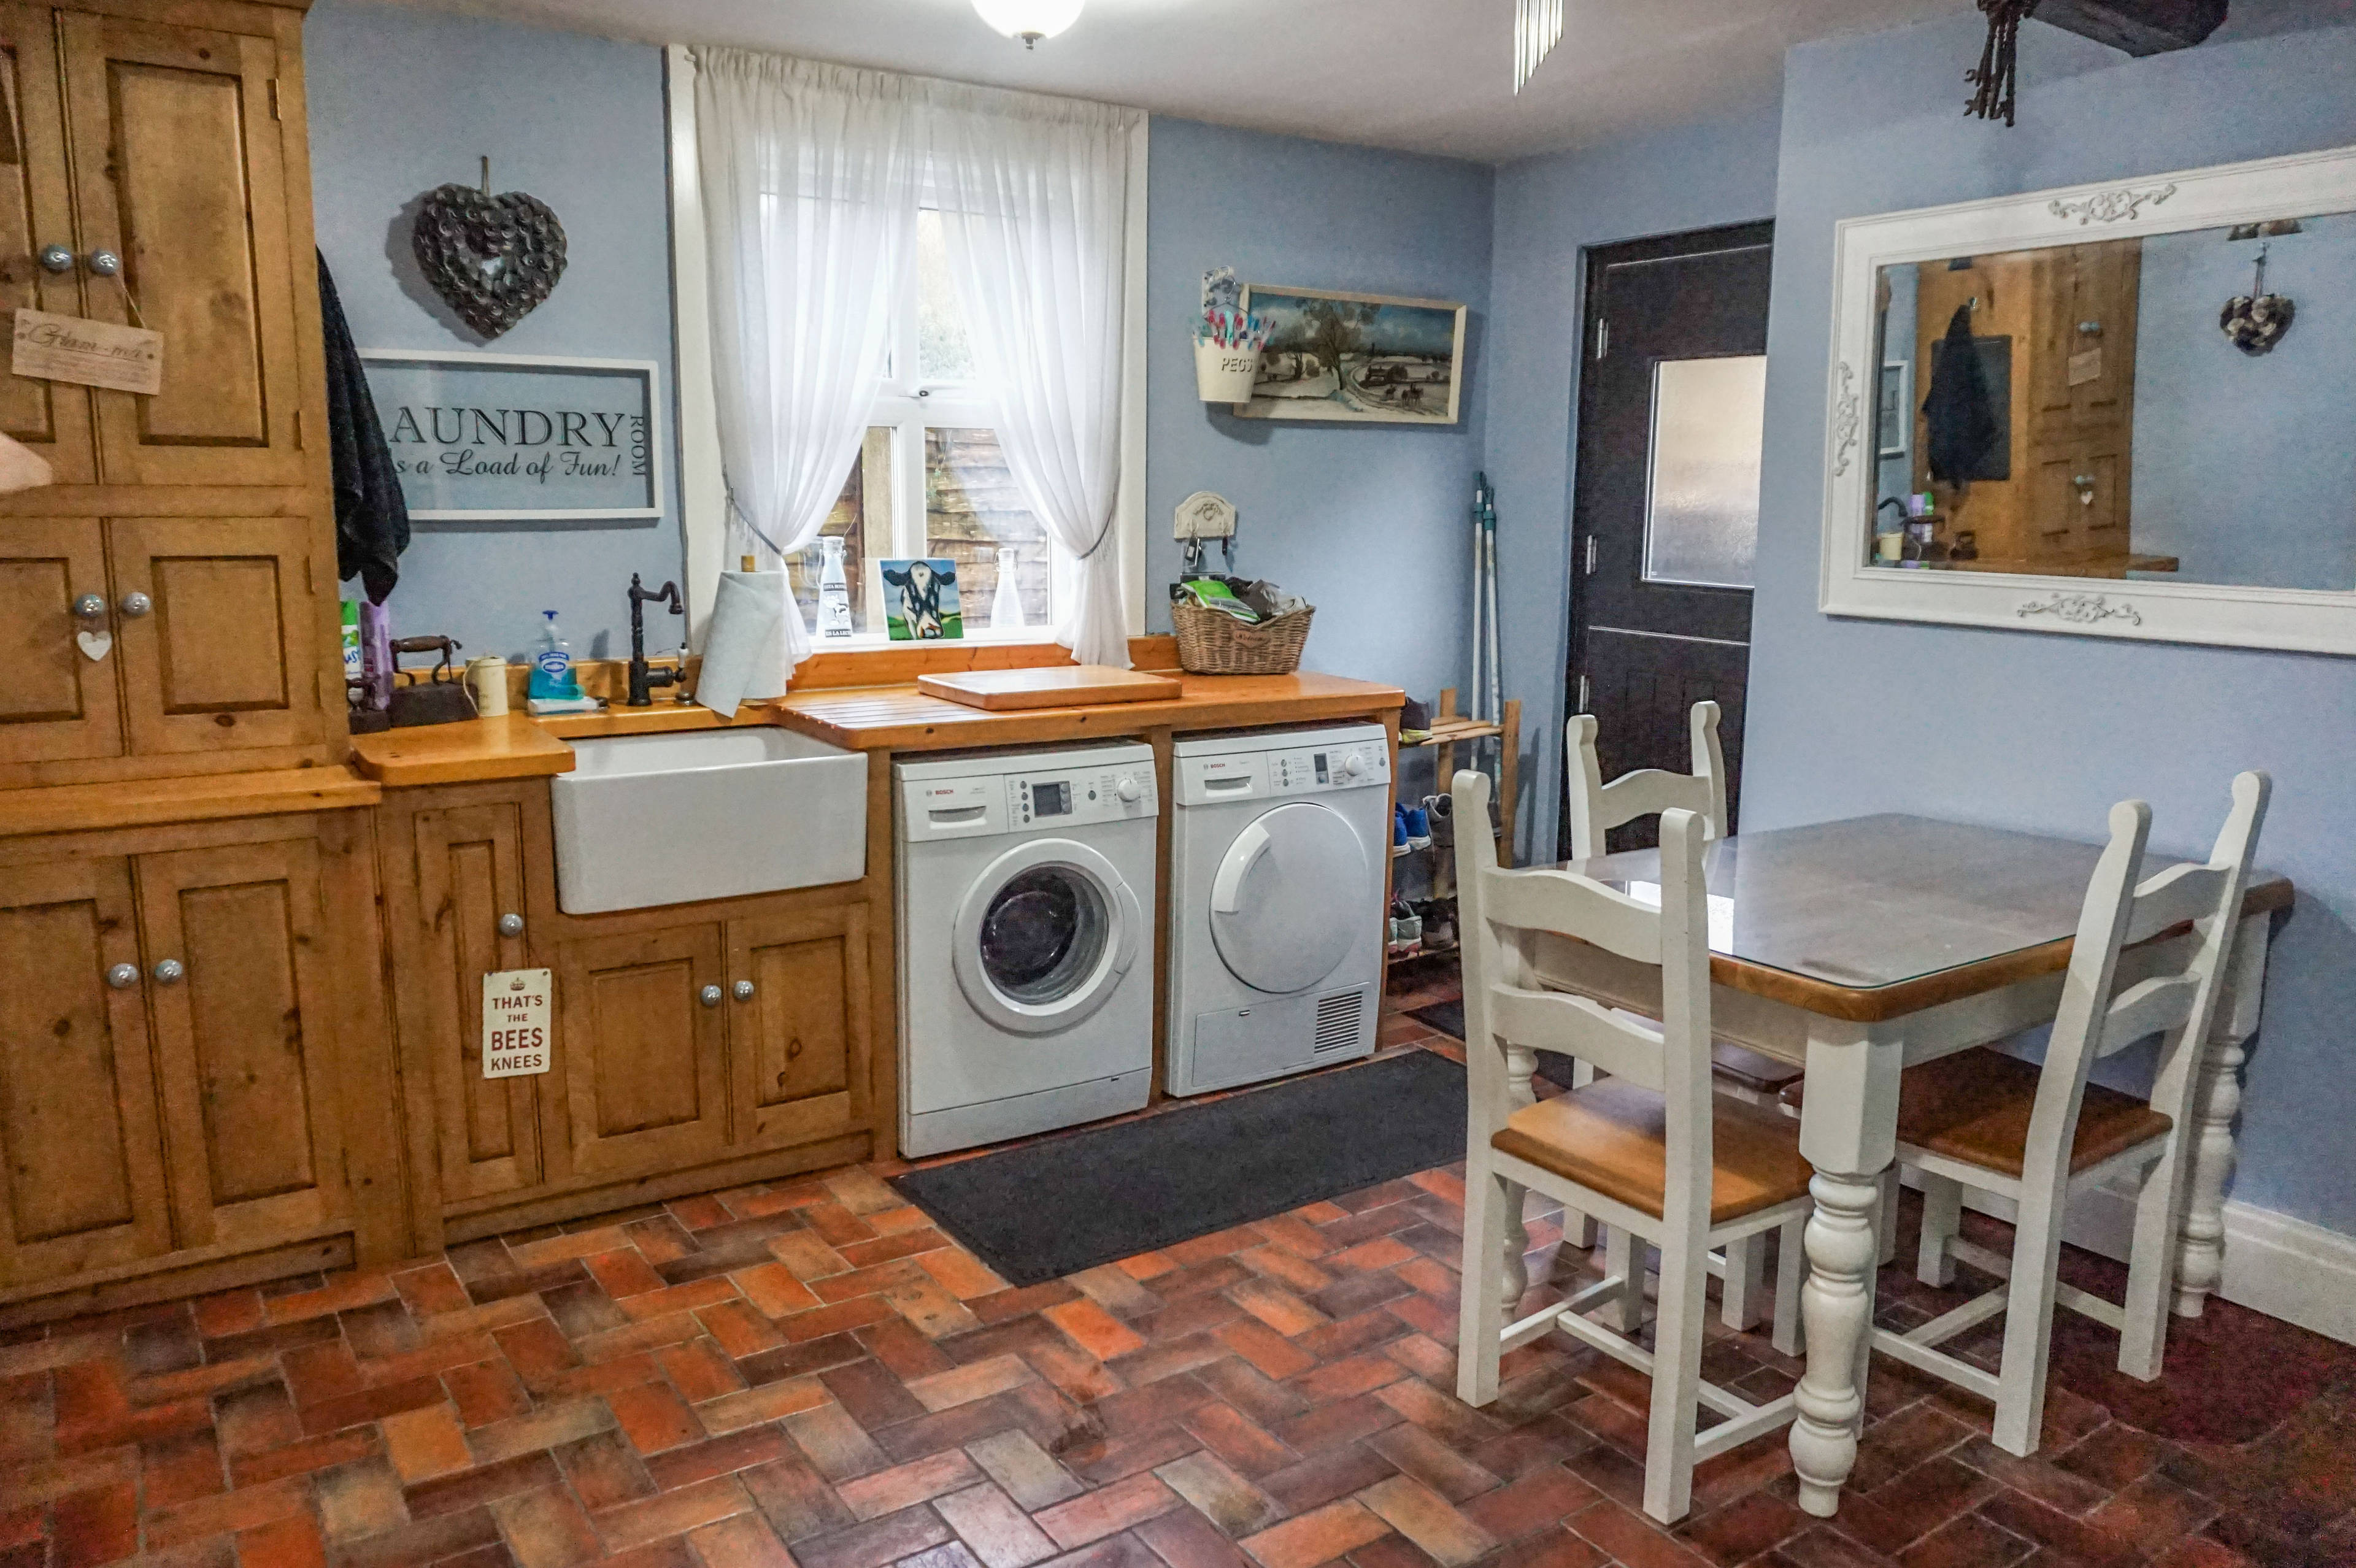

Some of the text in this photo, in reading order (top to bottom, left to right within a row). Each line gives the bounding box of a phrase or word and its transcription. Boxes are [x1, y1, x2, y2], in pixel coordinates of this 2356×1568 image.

[1222, 358, 1253, 372] PEGS
[390, 406, 625, 447] AUNDRY
[631, 415, 646, 475] ROOM
[416, 460, 432, 474] a
[440, 449, 520, 475] Load
[526, 451, 553, 485] of
[560, 451, 621, 477] Fun!
[492, 994, 543, 1010] THAT'S
[507, 1013, 528, 1023] THE
[491, 1027, 543, 1051] BEES
[491, 1054, 542, 1071] KNEES
